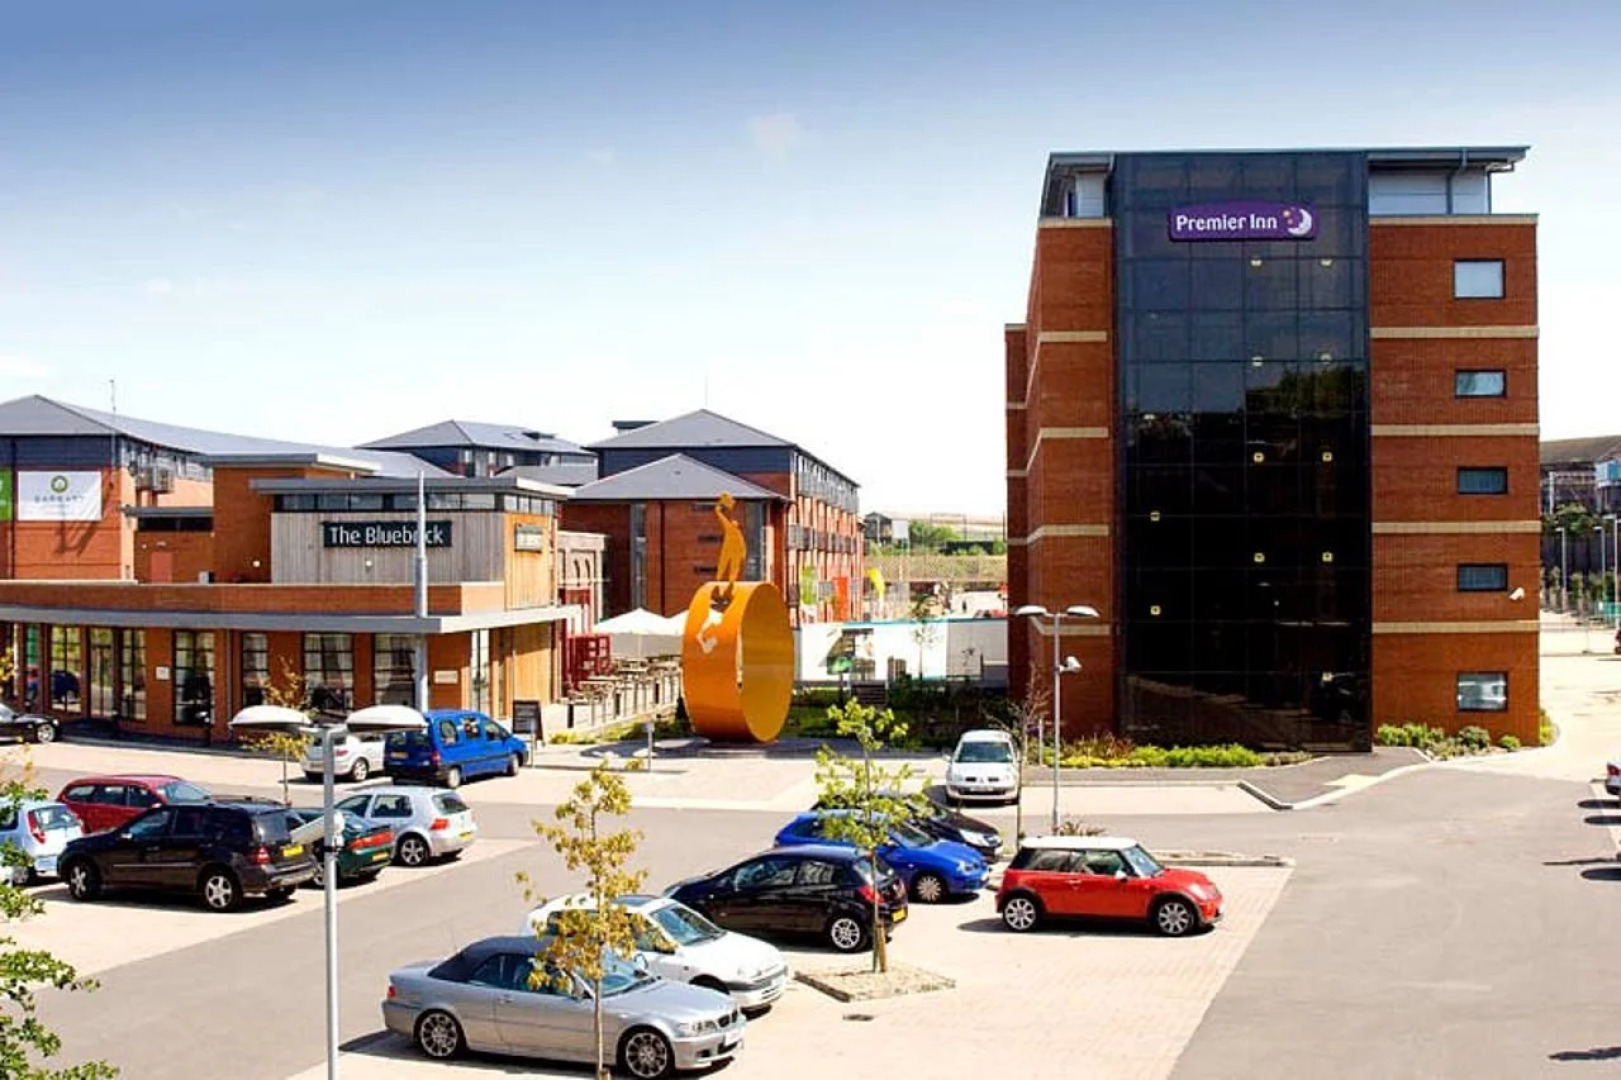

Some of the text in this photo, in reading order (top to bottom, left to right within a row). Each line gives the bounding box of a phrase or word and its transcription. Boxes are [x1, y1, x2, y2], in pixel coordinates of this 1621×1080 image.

[1176, 213, 1278, 231] Premier Inn
[329, 524, 444, 544] The Bluebrck
